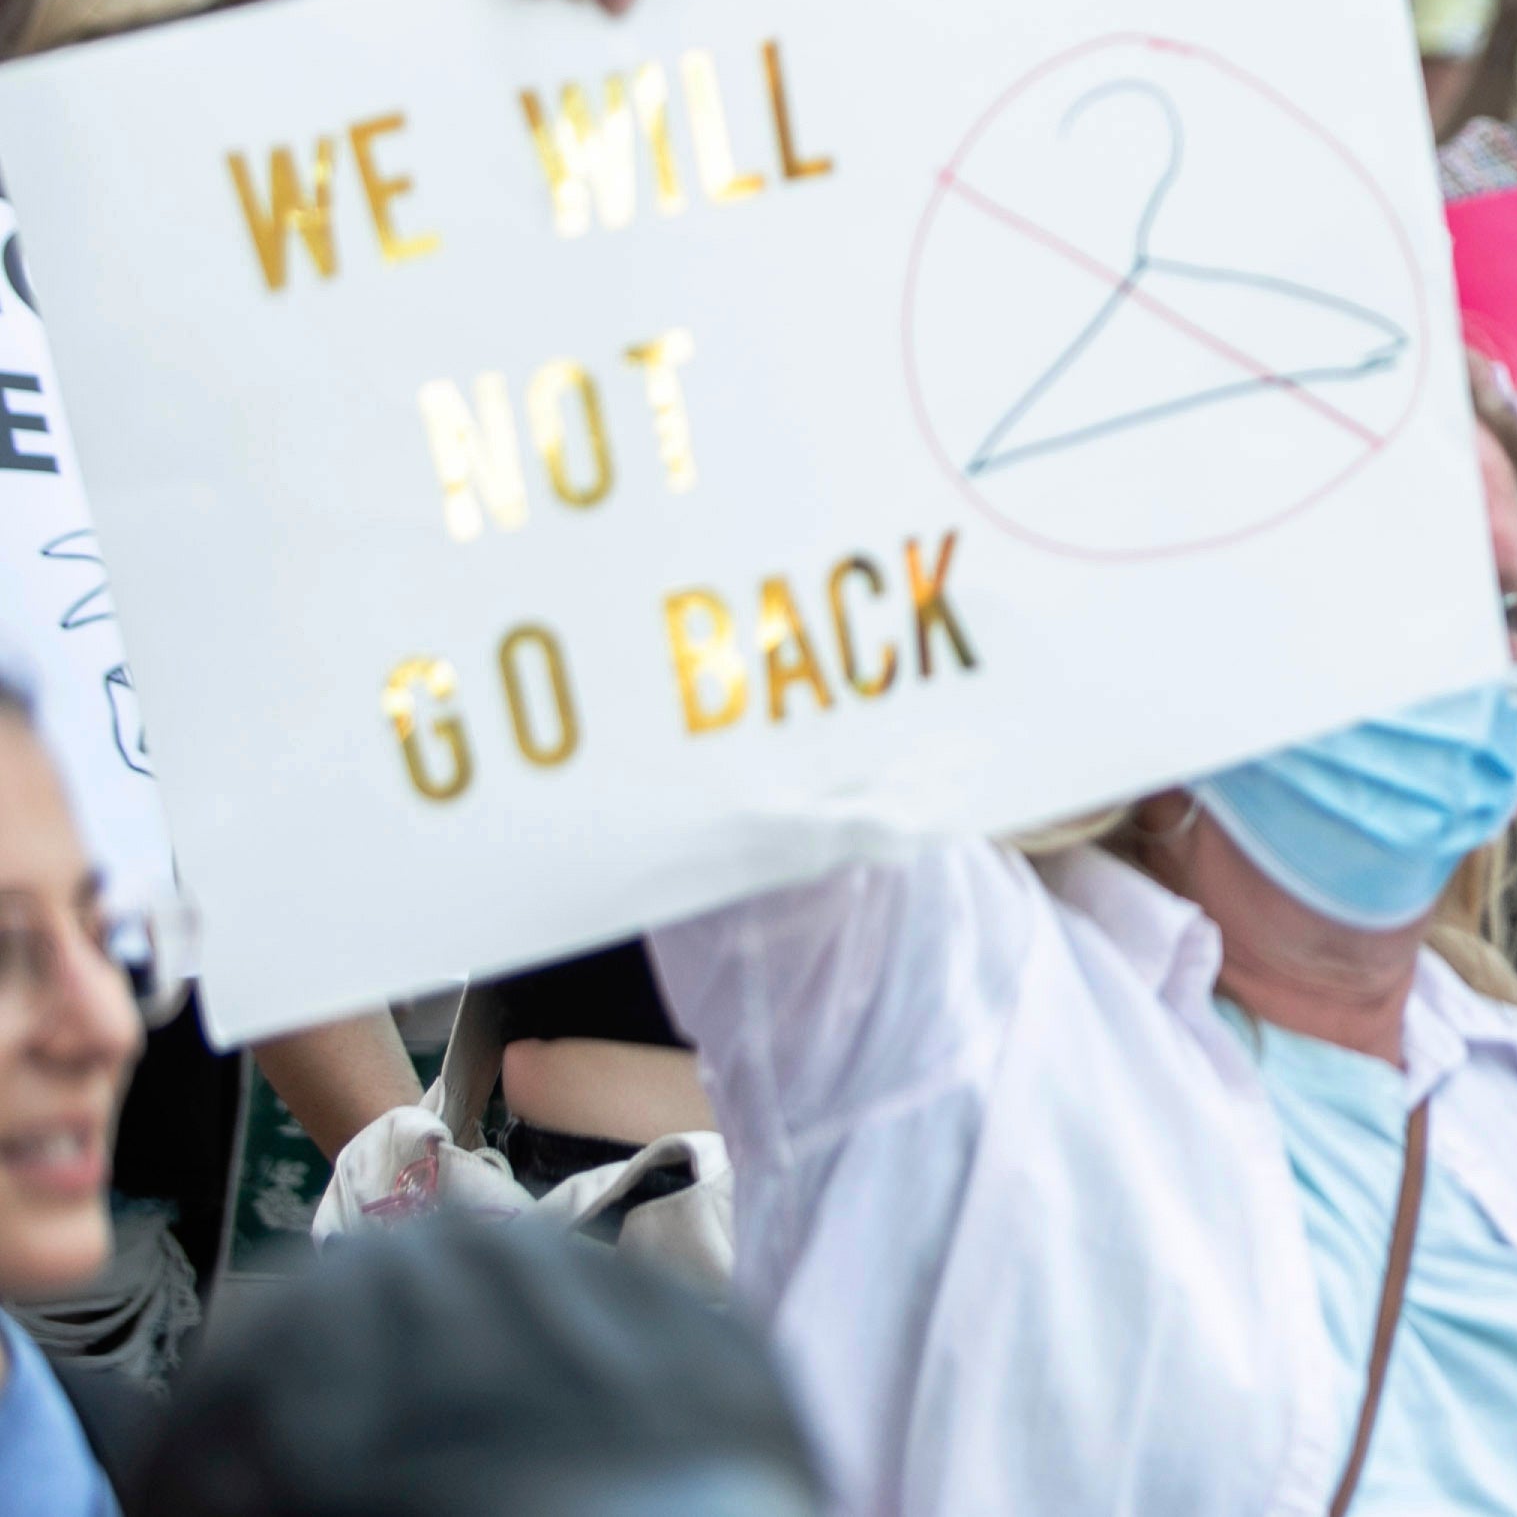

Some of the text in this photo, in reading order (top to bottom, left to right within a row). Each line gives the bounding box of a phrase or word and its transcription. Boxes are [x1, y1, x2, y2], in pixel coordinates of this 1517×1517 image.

[225, 111, 443, 293] WE
[519, 39, 834, 239] WILL
[417, 327, 699, 544] NOT
[381, 528, 979, 804] GO BACK
